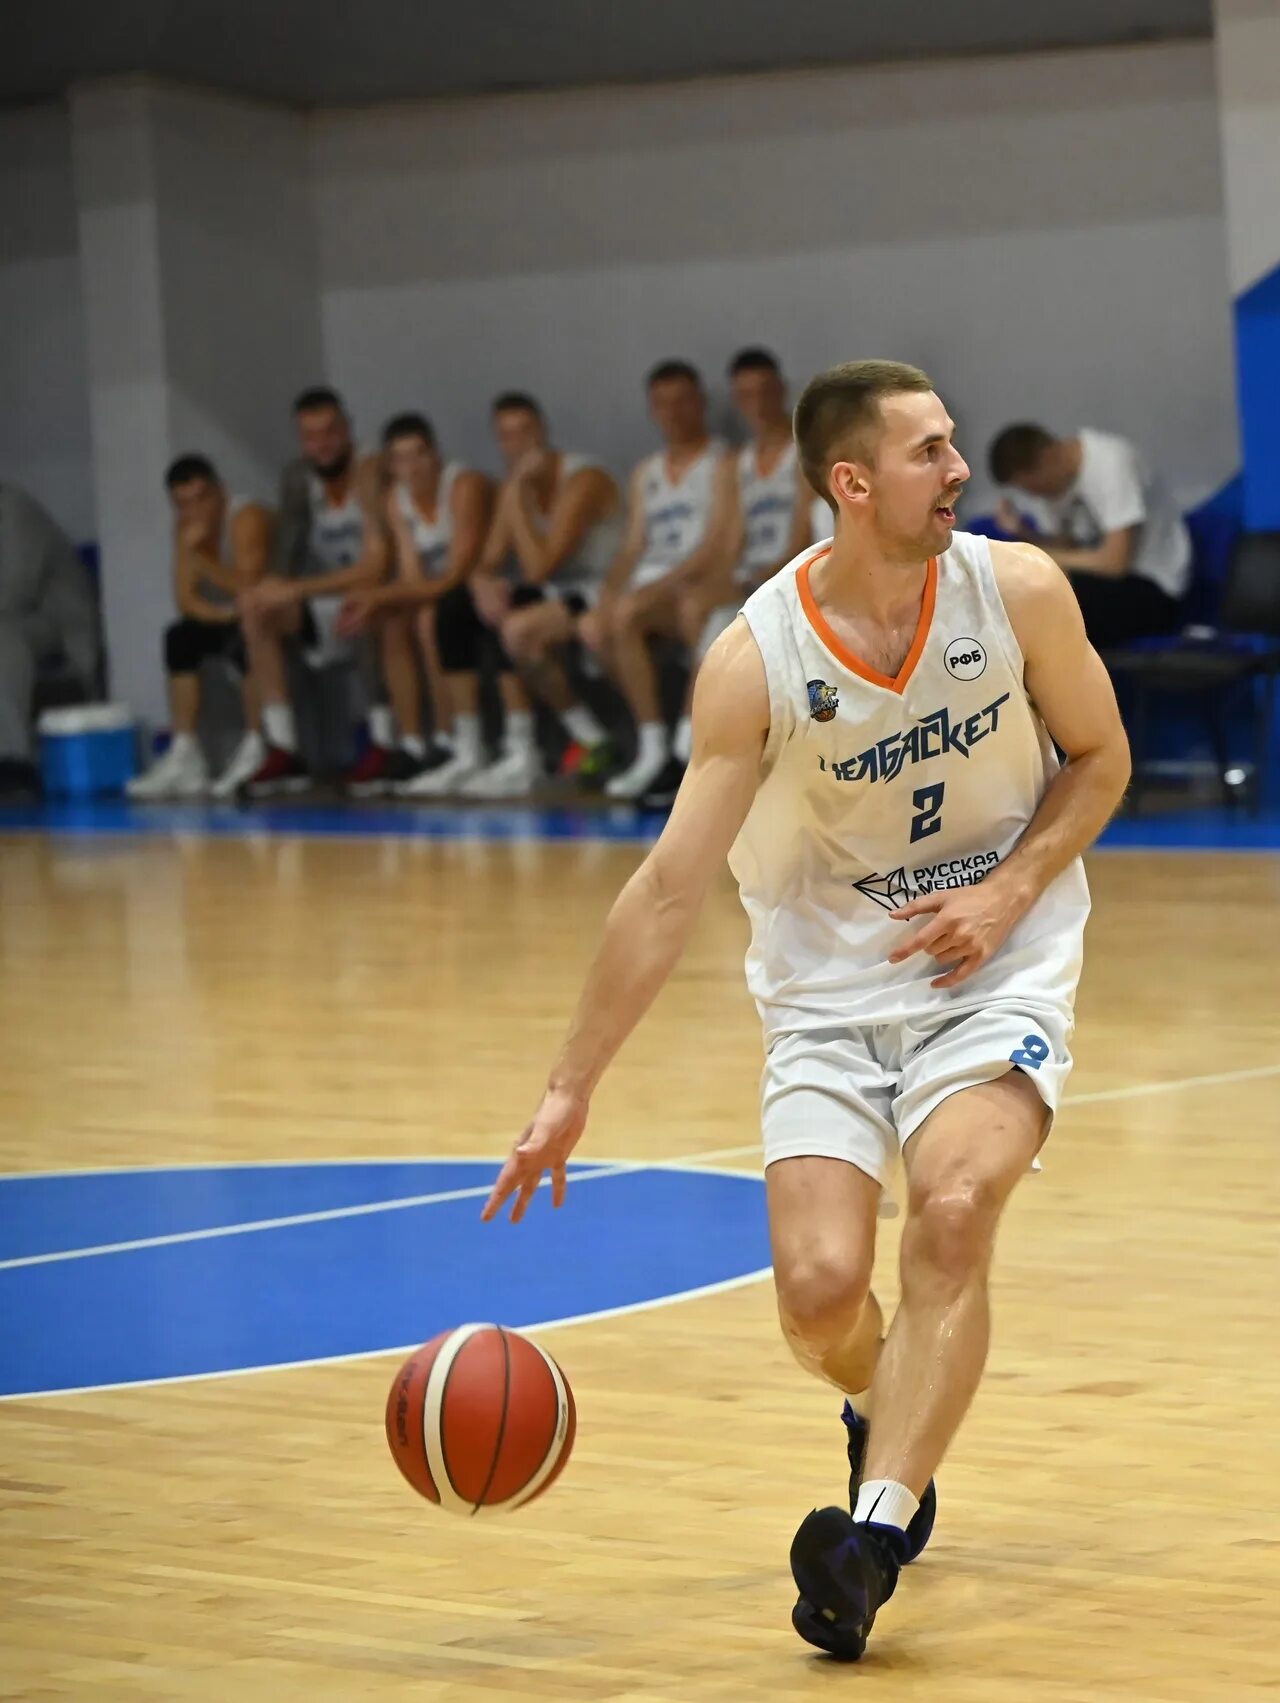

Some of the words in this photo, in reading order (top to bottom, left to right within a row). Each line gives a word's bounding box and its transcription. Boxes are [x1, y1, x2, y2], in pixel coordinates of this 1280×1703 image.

[949, 650, 982, 669] РФБ
[910, 781, 945, 844] 2
[913, 851, 999, 883] РУССКАЯ
[918, 868, 993, 896] МЕДНА
[1009, 1034, 1050, 1070] 2
